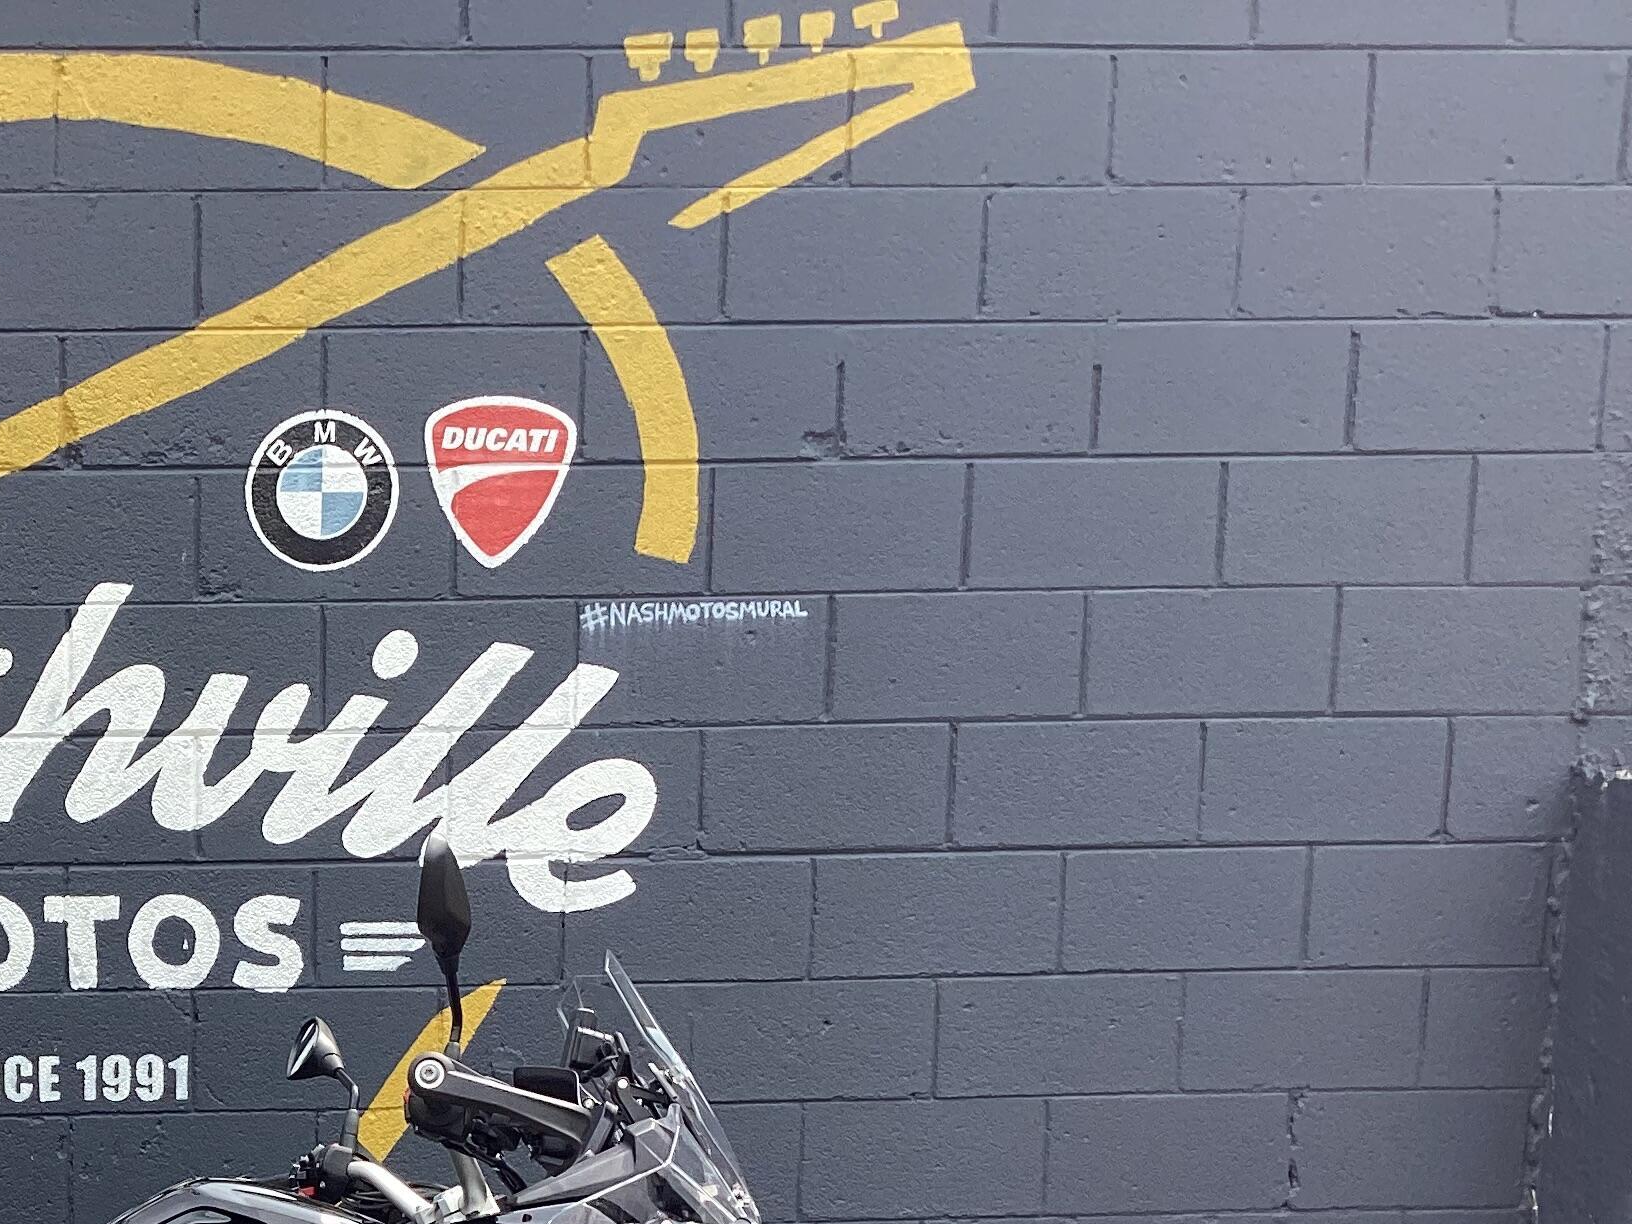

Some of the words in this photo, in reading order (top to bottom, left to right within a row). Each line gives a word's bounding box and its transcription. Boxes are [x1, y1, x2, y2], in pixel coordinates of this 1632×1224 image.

[266, 421, 382, 466] BMW
[442, 427, 560, 453] DUCATI
[579, 600, 809, 632] #NASHMOTOSMURAL
[76, 1054, 188, 1101] 1991
